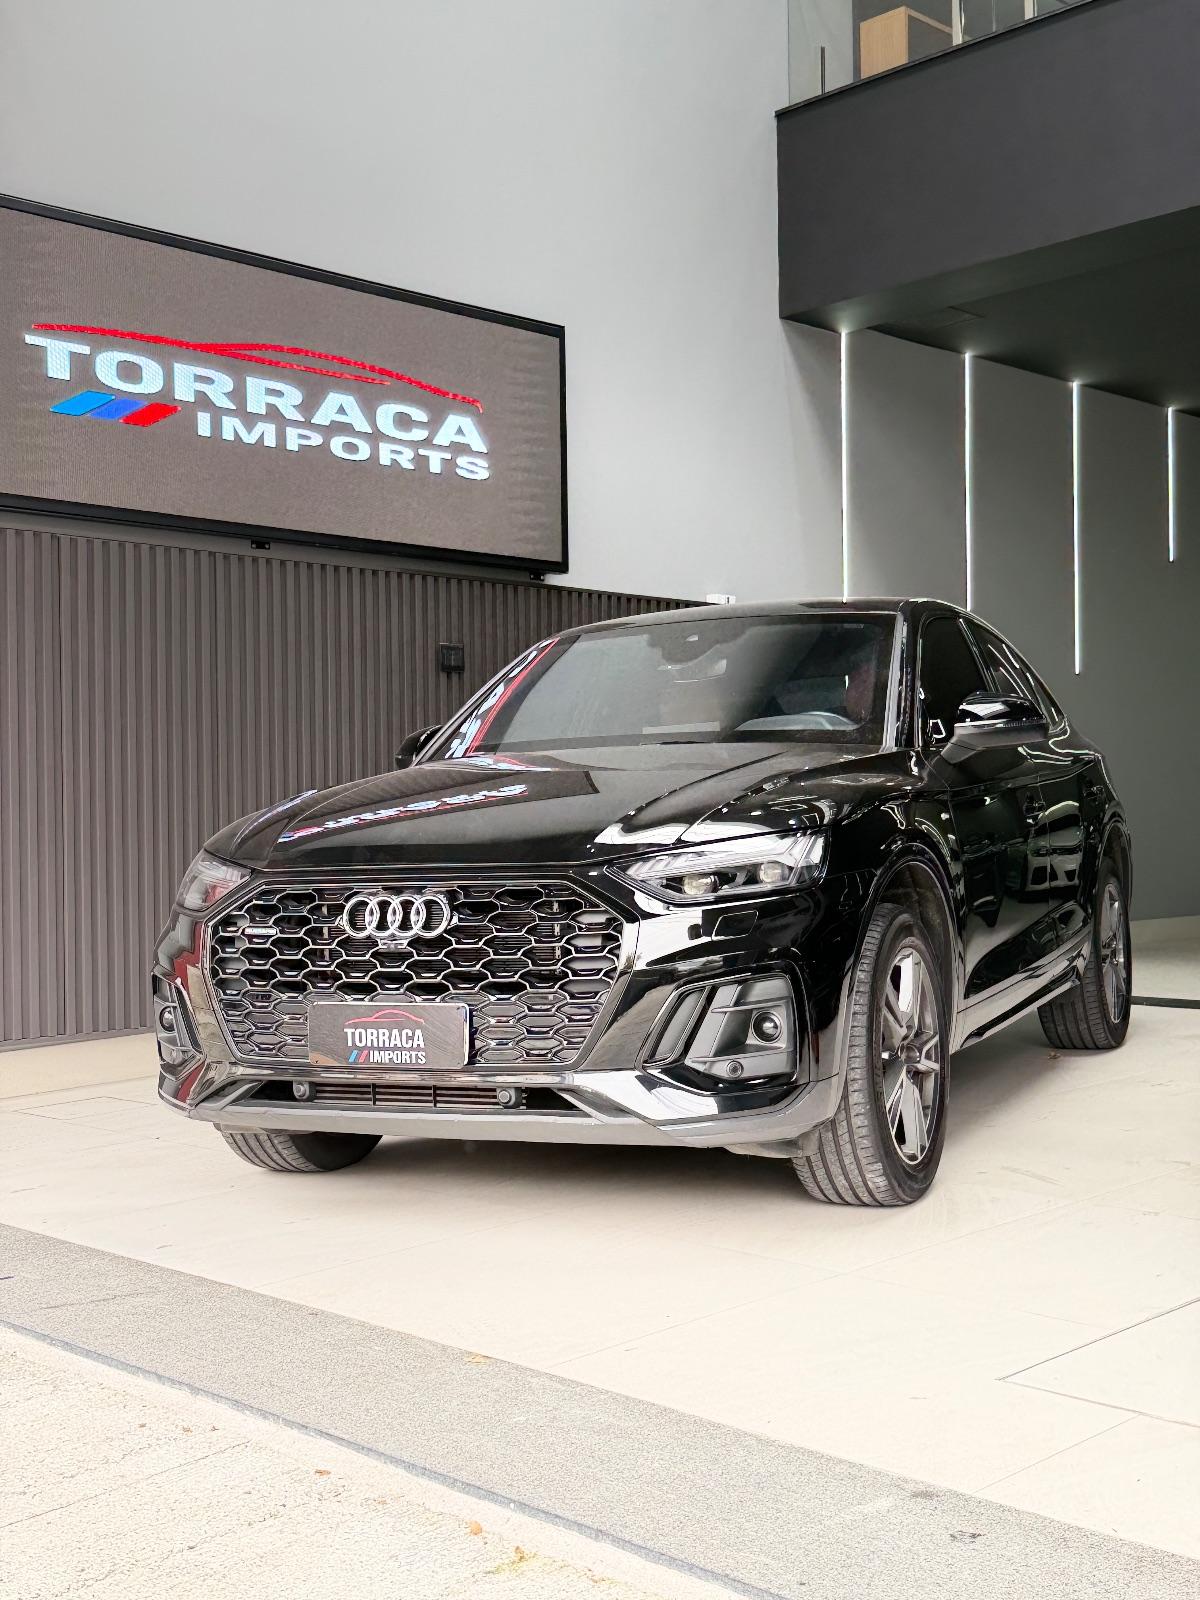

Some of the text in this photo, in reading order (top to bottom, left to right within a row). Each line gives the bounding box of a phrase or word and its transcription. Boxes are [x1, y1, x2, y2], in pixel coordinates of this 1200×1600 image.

[24, 334, 488, 453] TORRACA
[196, 411, 491, 481] IMPORTS
[344, 1028, 425, 1048] TORRACA
[369, 1050, 426, 1064] IMPORTS
